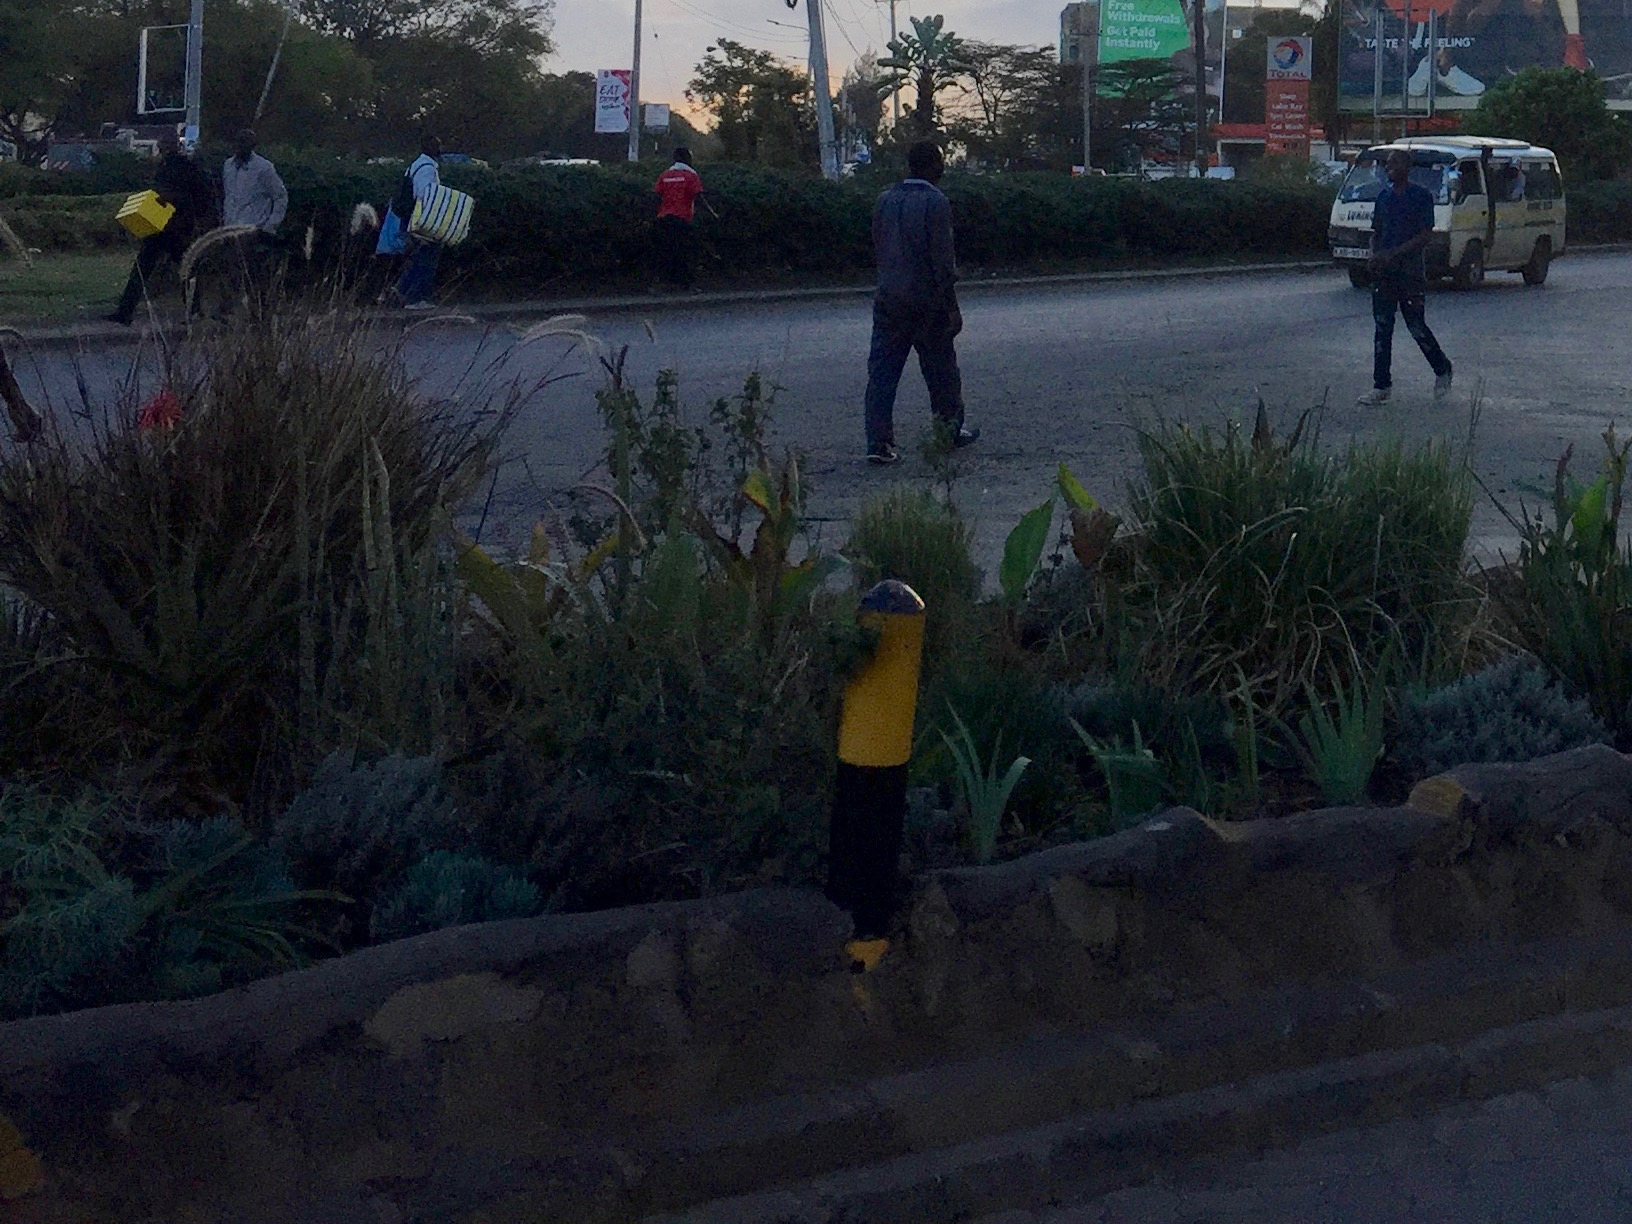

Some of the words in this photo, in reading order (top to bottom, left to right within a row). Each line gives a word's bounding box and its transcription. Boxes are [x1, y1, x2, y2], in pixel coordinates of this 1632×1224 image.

[1108, 0, 1135, 11] Free
[1107, 11, 1180, 24] Withdrawals
[1107, 26, 1128, 37] Get
[1130, 26, 1156, 37] Paid
[1106, 37, 1160, 51] Instantly
[1364, 38, 1399, 49] TATE
[1269, 69, 1307, 78] TOTAL
[600, 84, 622, 96] EAT
